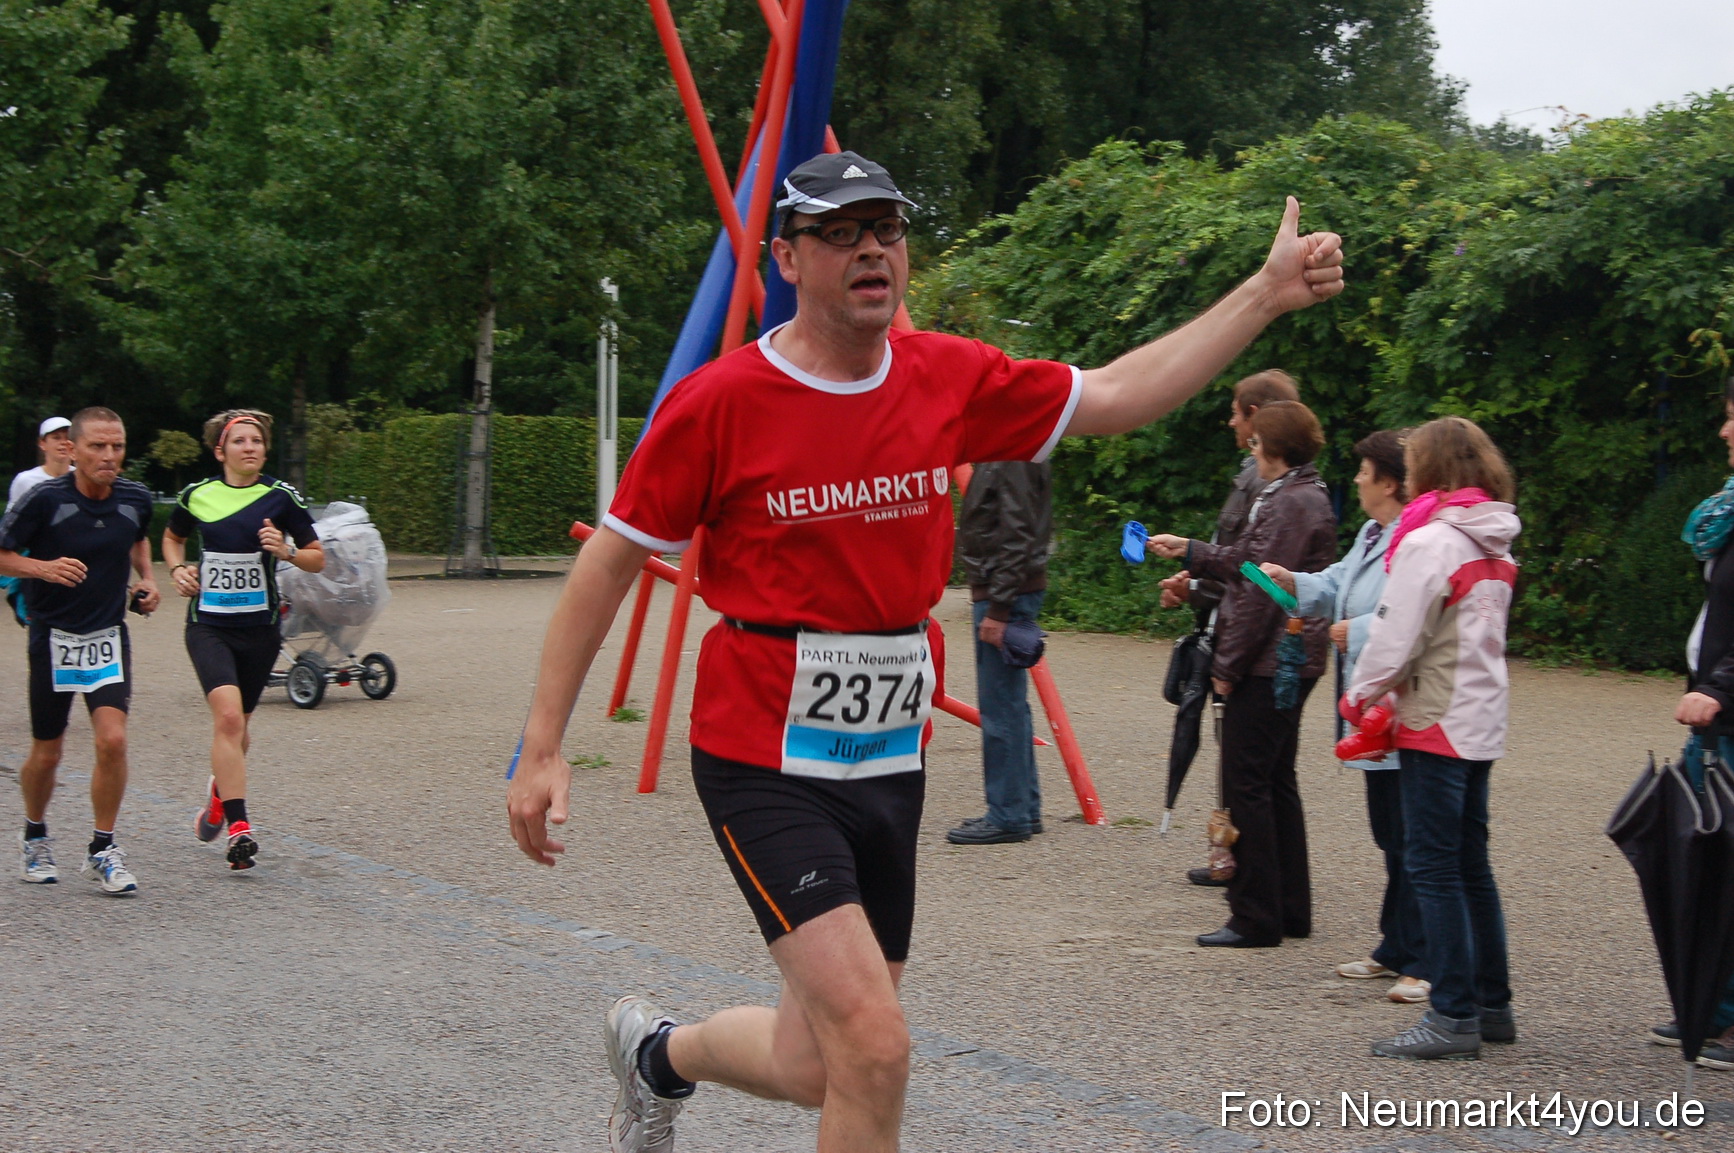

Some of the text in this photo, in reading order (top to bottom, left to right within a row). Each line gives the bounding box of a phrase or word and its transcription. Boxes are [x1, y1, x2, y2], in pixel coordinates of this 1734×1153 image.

[766, 470, 928, 517] NEUMARKT
[864, 504, 929, 523] STARKE STADT
[208, 567, 261, 590] 2588
[59, 641, 113, 667] 2709
[801, 649, 918, 666] PARTL Neumarkt
[806, 671, 924, 724] 2374
[828, 737, 887, 761] Jürgen
